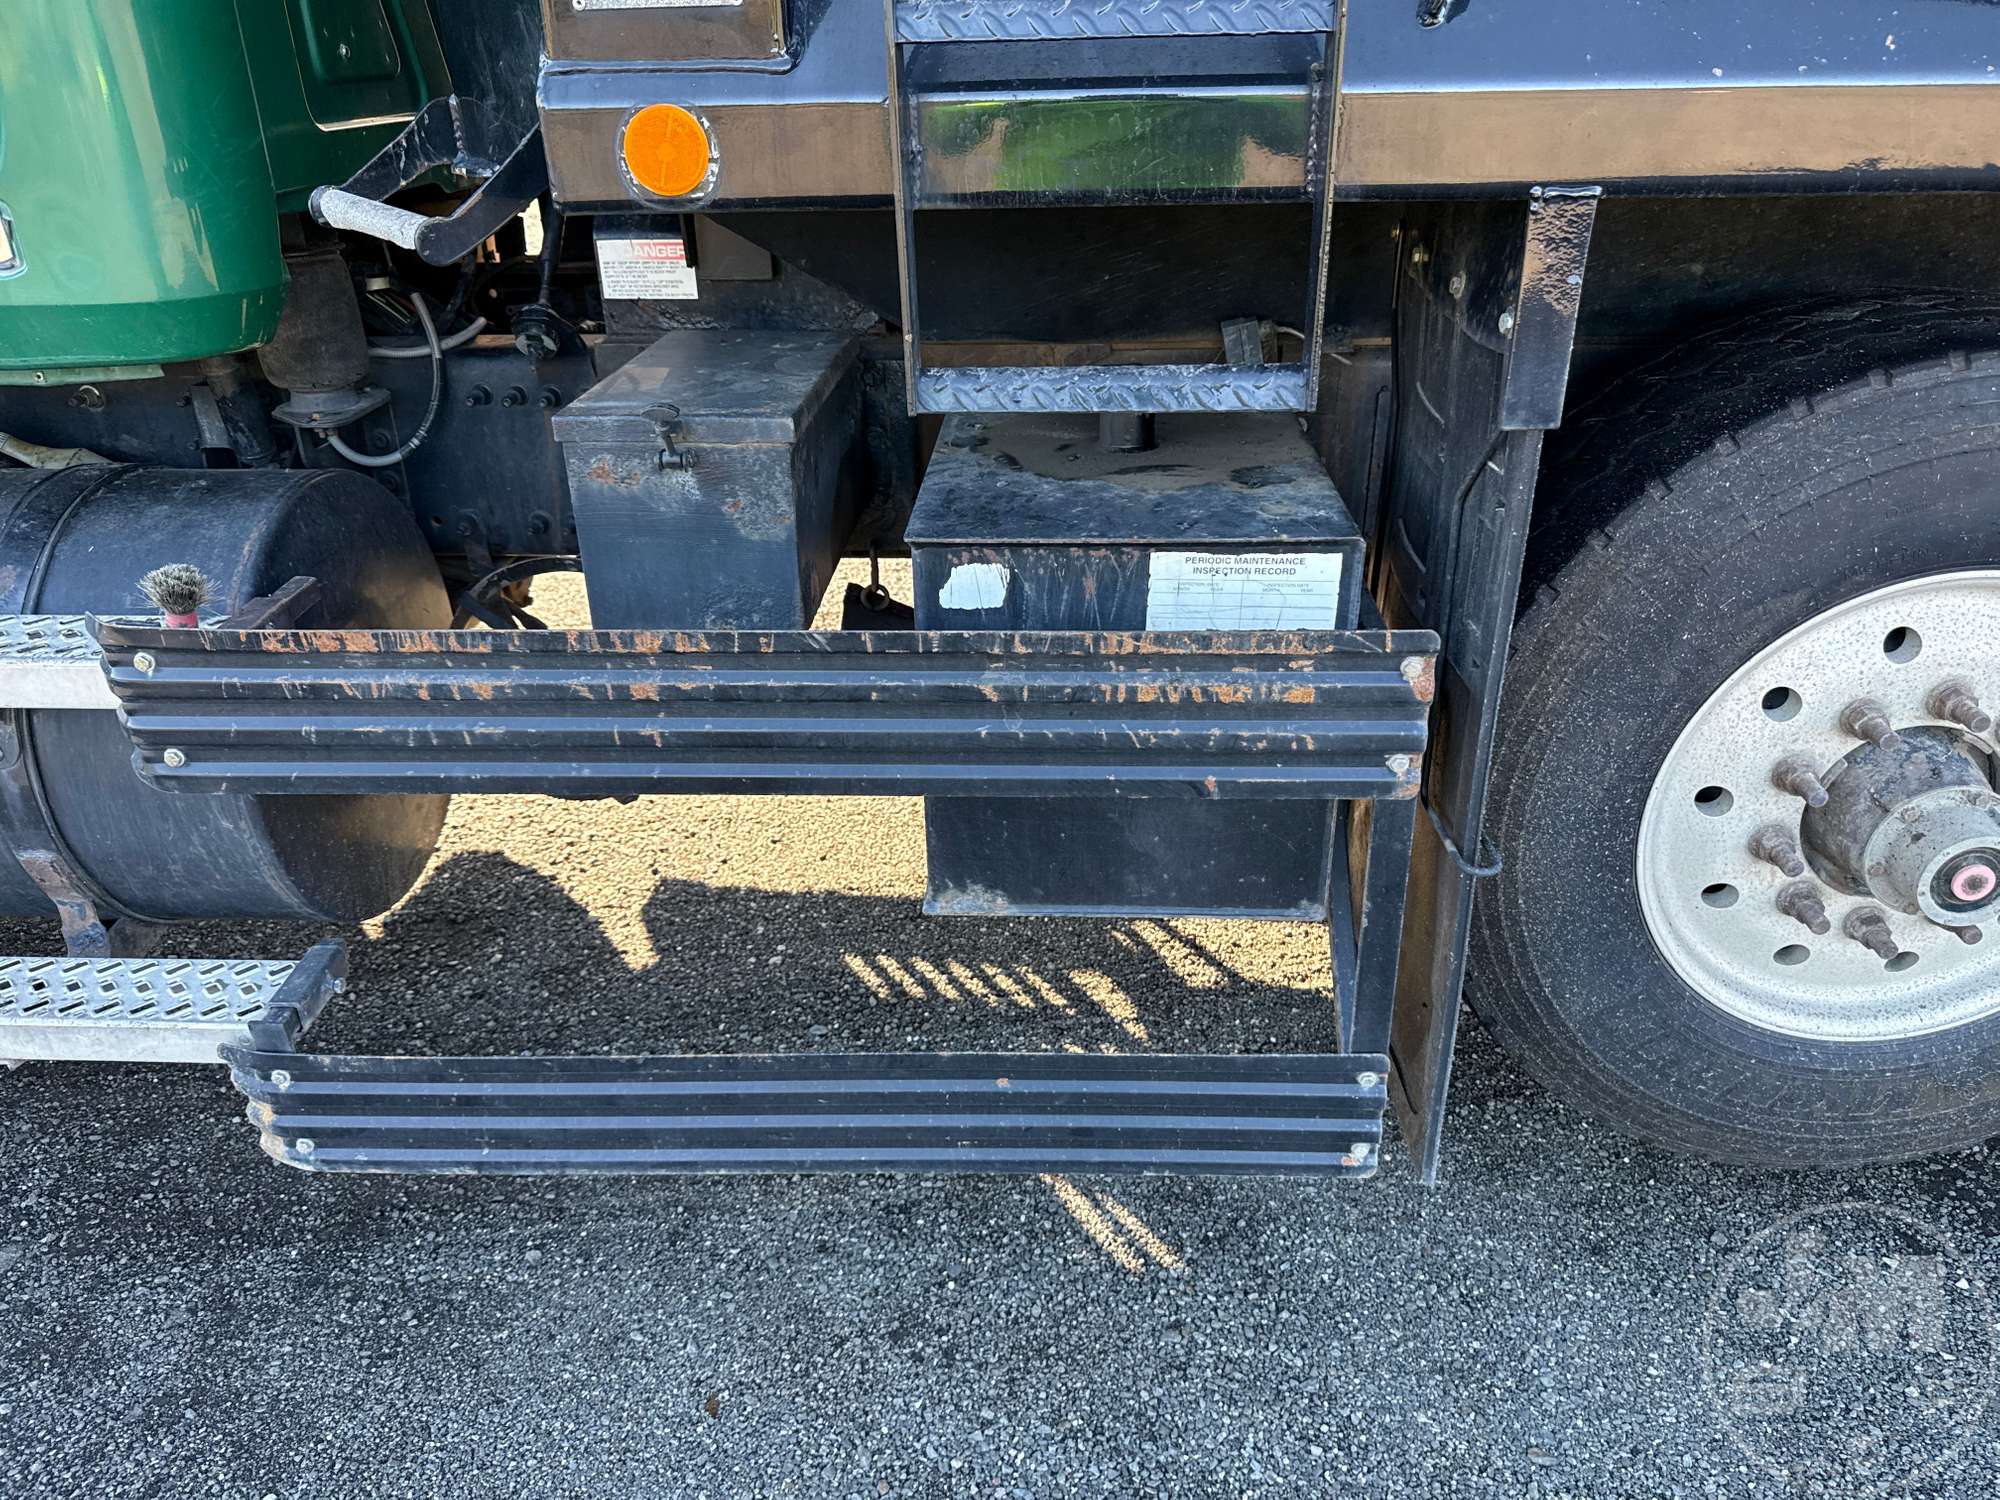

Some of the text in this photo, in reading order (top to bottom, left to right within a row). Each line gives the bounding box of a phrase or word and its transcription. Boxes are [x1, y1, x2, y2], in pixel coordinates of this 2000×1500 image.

[623, 245, 686, 257] ANGER
[1184, 556, 1306, 565] PERIODIC MAINTENANCE
[1192, 567, 1297, 576] INSPECTION RECORD
